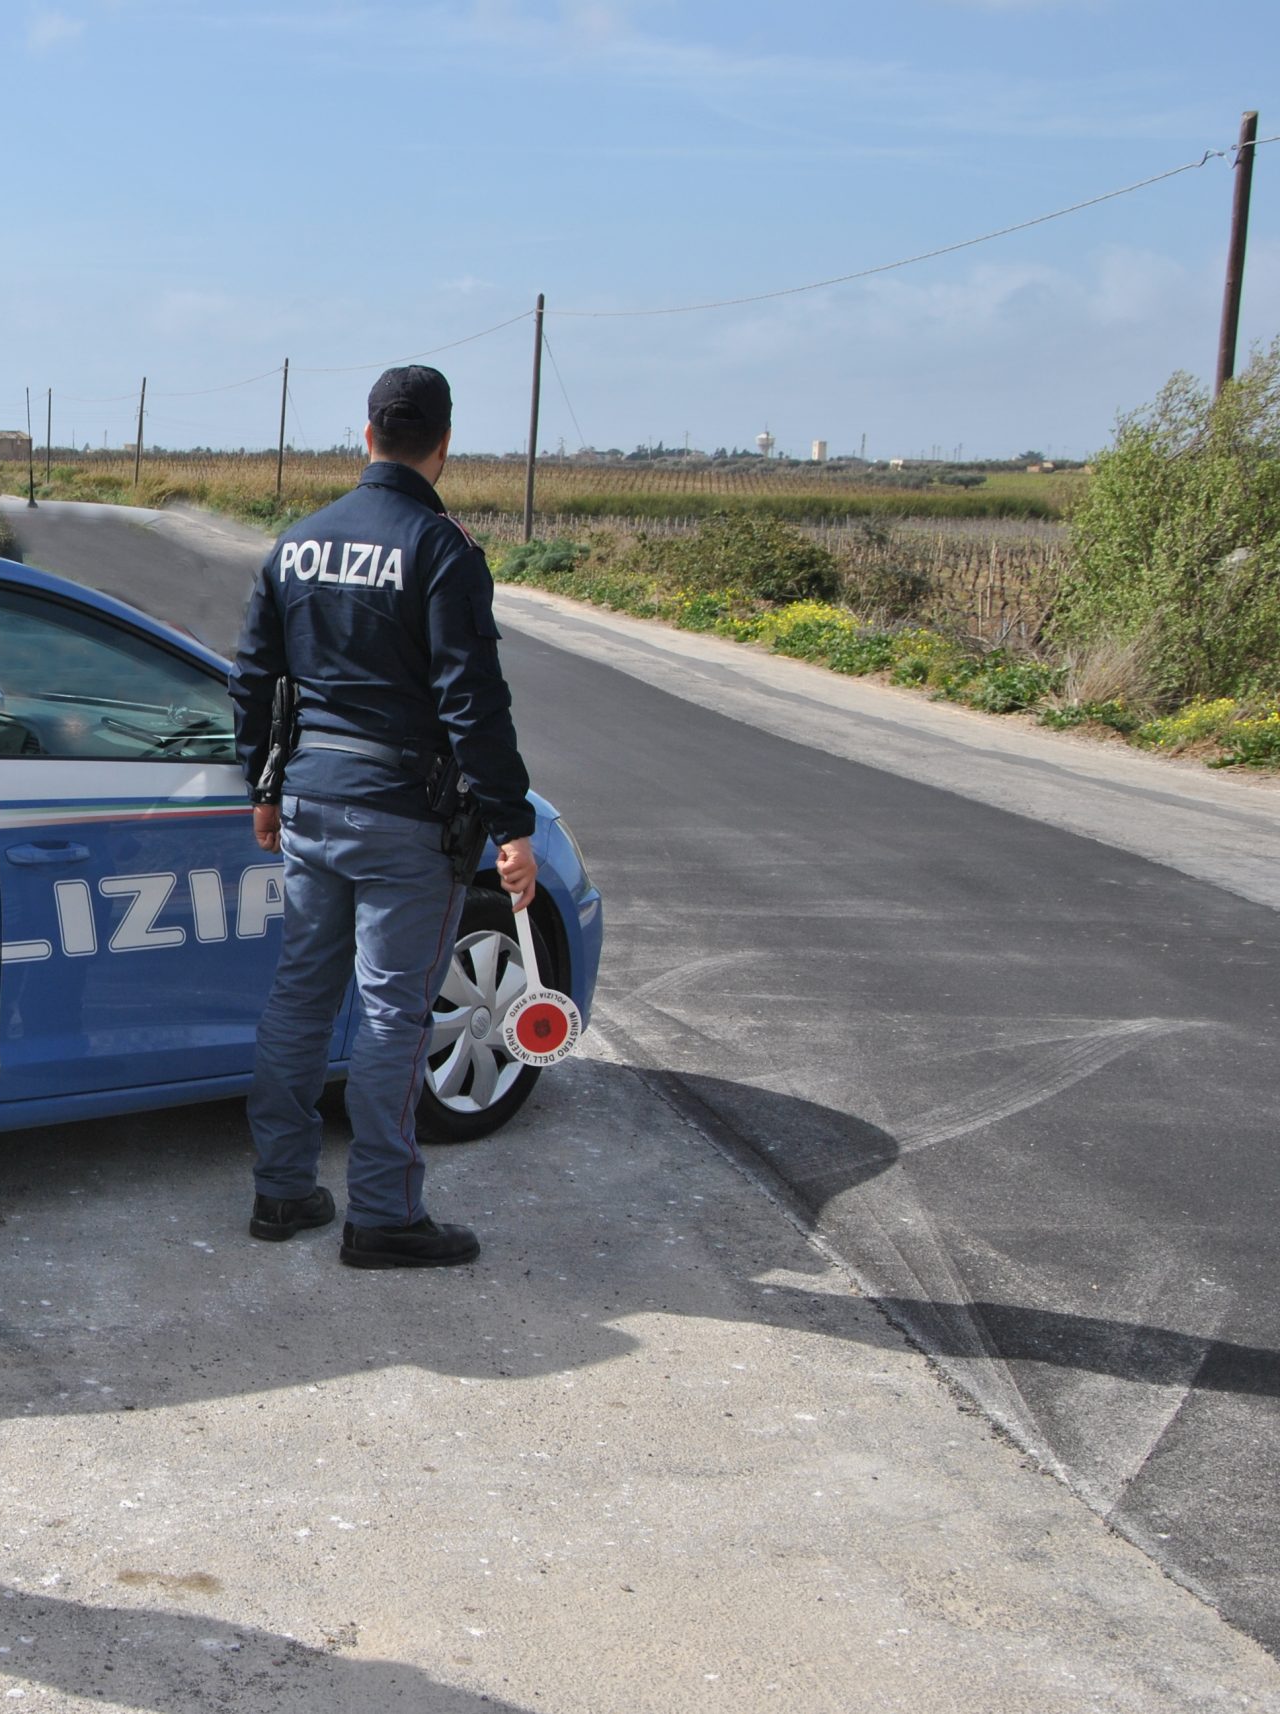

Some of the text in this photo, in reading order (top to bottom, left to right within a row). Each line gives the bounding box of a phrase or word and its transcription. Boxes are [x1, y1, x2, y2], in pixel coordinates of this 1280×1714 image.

[279, 539, 404, 591] POLIZIA
[509, 998, 528, 1018] STATO
[539, 992, 567, 1006] POLIZIA
[557, 1011, 579, 1057] MINISTERO
